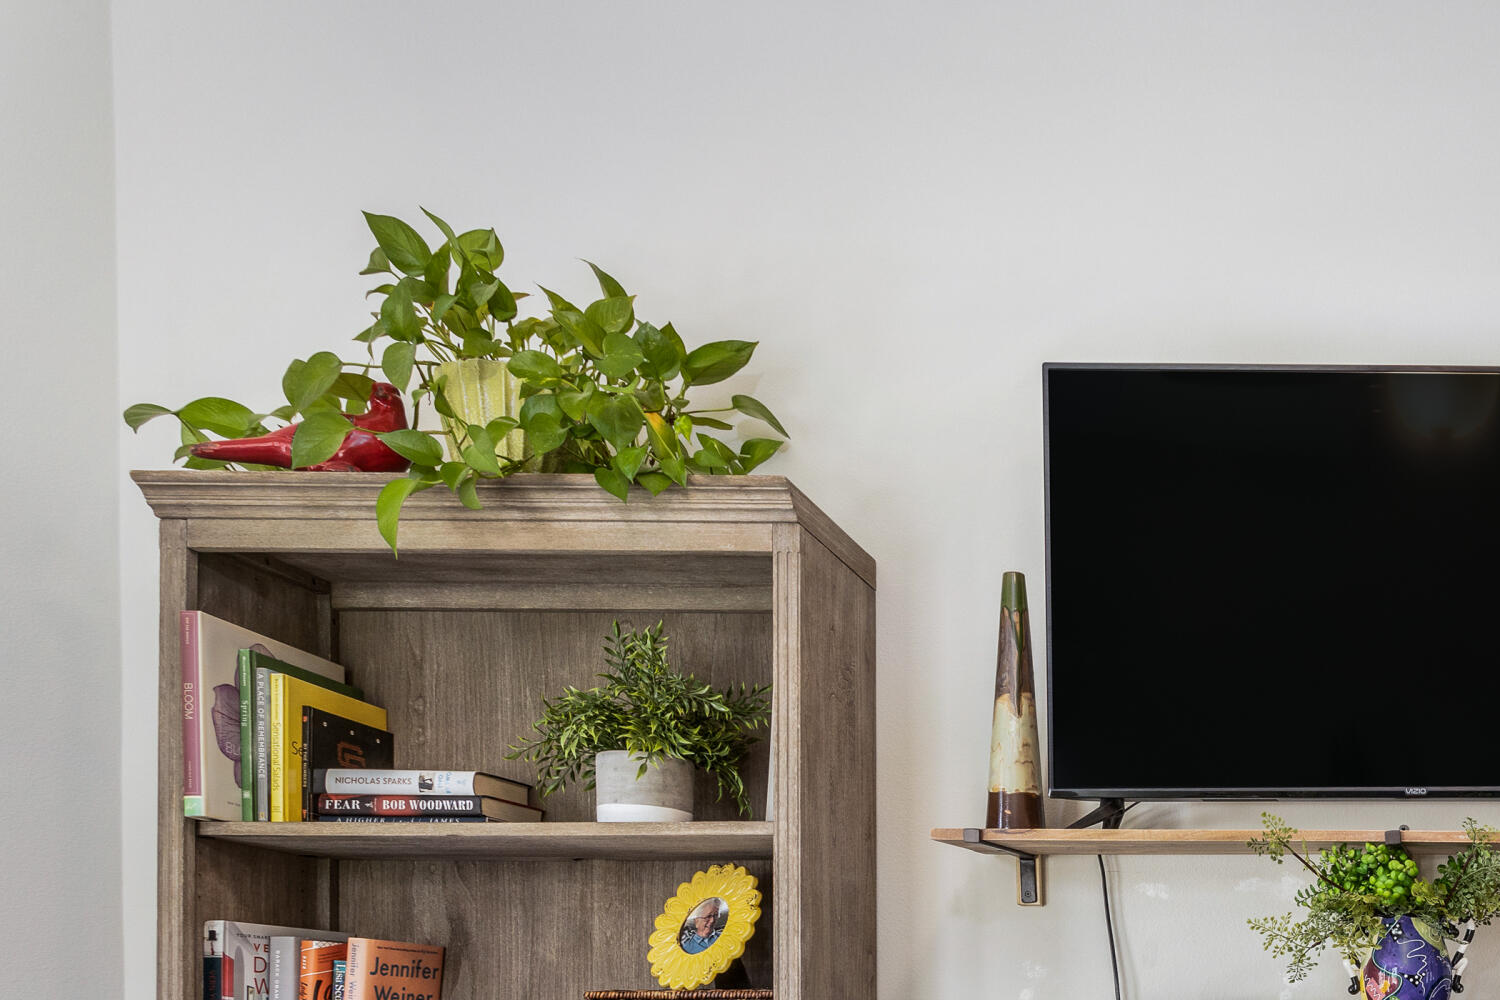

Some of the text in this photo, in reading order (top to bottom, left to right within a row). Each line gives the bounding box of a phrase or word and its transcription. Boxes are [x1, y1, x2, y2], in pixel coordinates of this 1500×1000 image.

[184, 682, 194, 720] BLOOM
[257, 708, 264, 718] OF
[257, 720, 265, 779] REMEMBRANCE
[271, 722, 281, 766] Sensational
[272, 767, 280, 792] Salads
[335, 776, 413, 785] NICHOLAS SPARKS
[324, 799, 474, 811] FEAR BOB WOODWARD
[350, 943, 360, 976] Jennifer
[369, 957, 439, 979] Jennifer
[335, 963, 346, 984] Lisa
